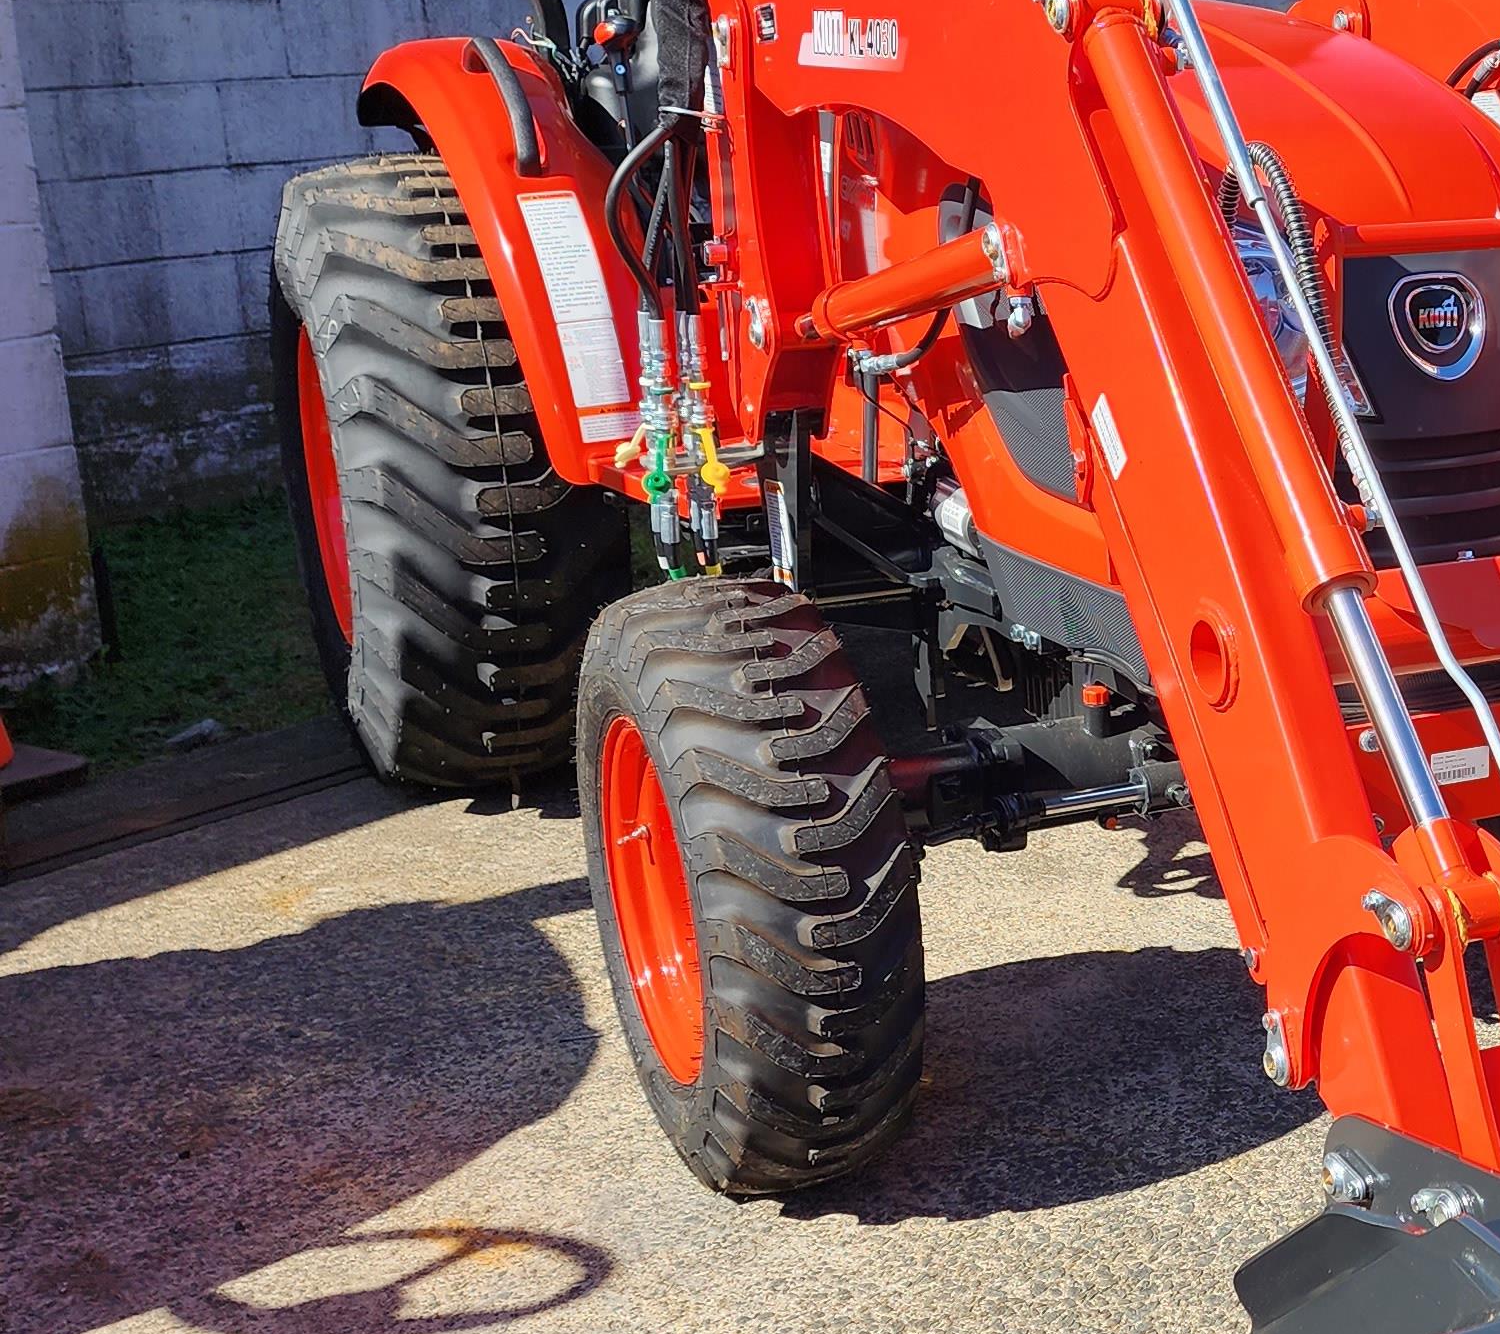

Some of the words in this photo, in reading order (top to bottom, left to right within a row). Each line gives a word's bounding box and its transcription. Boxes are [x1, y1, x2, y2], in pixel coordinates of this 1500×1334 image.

[813, 9, 845, 57] KIOTI
[848, 18, 865, 58] KL
[866, 18, 898, 59] 4030
[1418, 306, 1458, 329] KIOTI
